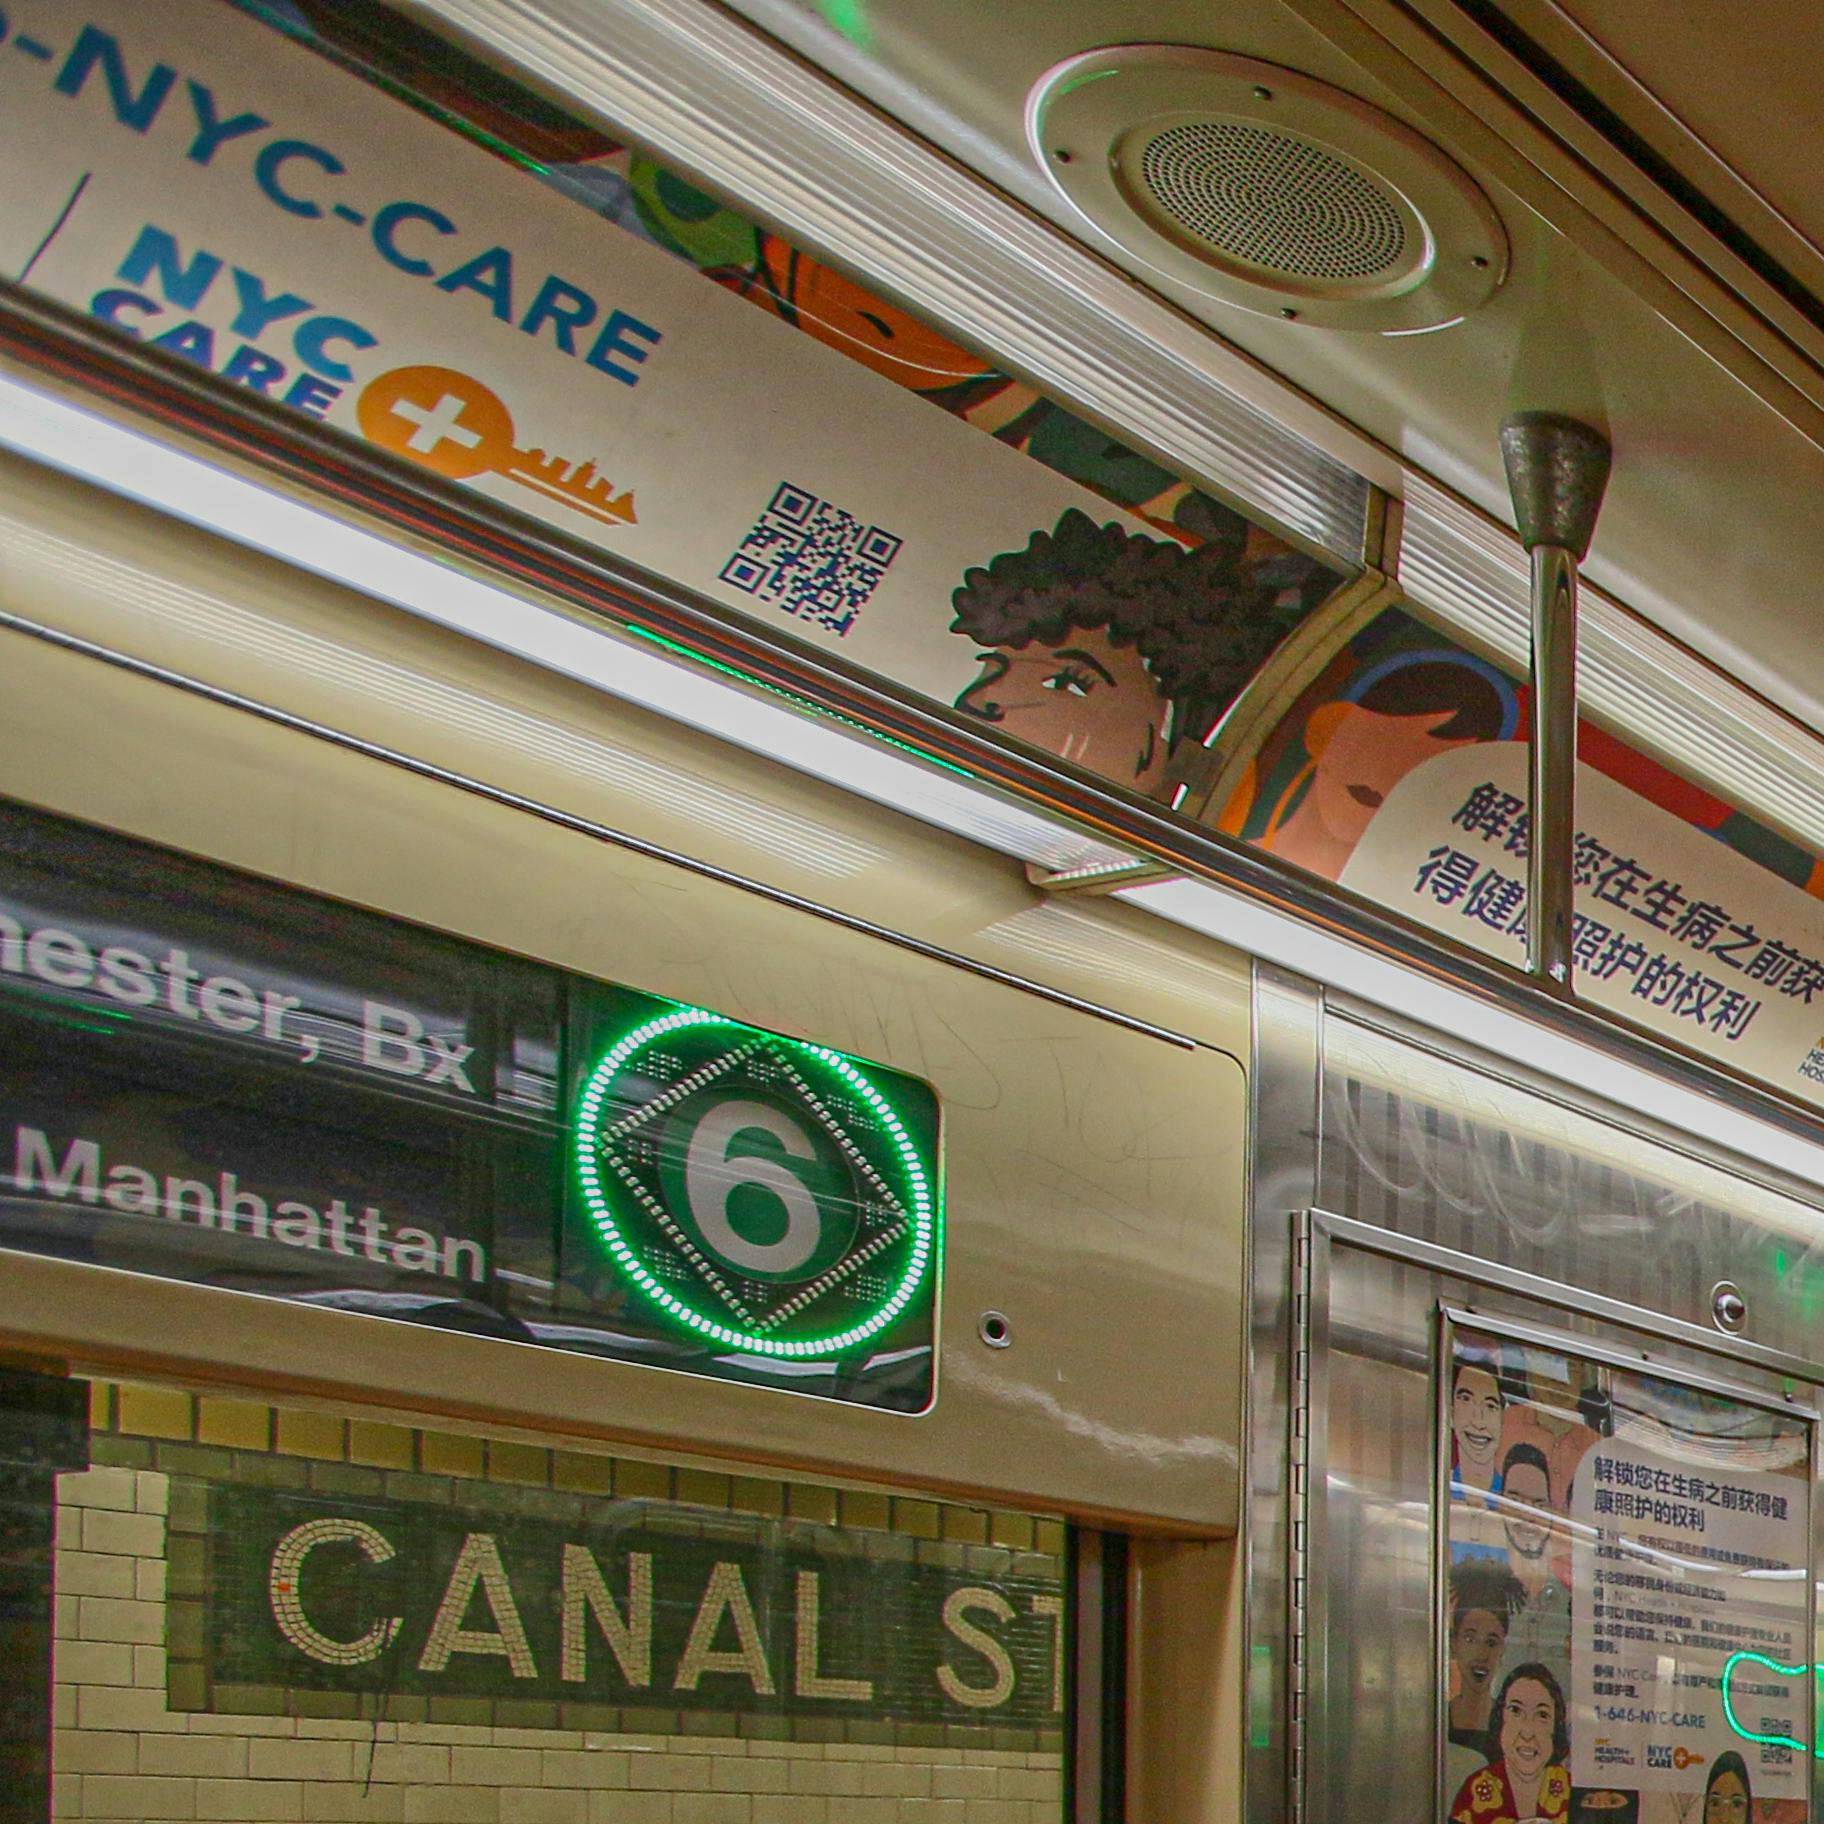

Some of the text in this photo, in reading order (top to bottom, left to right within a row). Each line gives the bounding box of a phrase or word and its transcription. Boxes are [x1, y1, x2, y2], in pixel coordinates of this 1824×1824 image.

[0, 0, 663, 387] -NYC-CARE
[92, 288, 343, 421] CARE
[116, 223, 379, 383] NYC
[362, 1001, 476, 1093] Bx
[13, 1127, 486, 1283] Manhattan
[684, 1098, 822, 1273] 6
[1594, 1456, 1788, 1521] 解锁您在生病之前获得健
[1594, 1488, 1706, 1532] 康照护的权利
[269, 1516, 875, 1700] CANAL
[1594, 1705, 1706, 1729] 1-646-NYC-CARE
[1647, 1744, 1673, 1757] NYC
[1647, 1757, 1673, 1769] CARE
